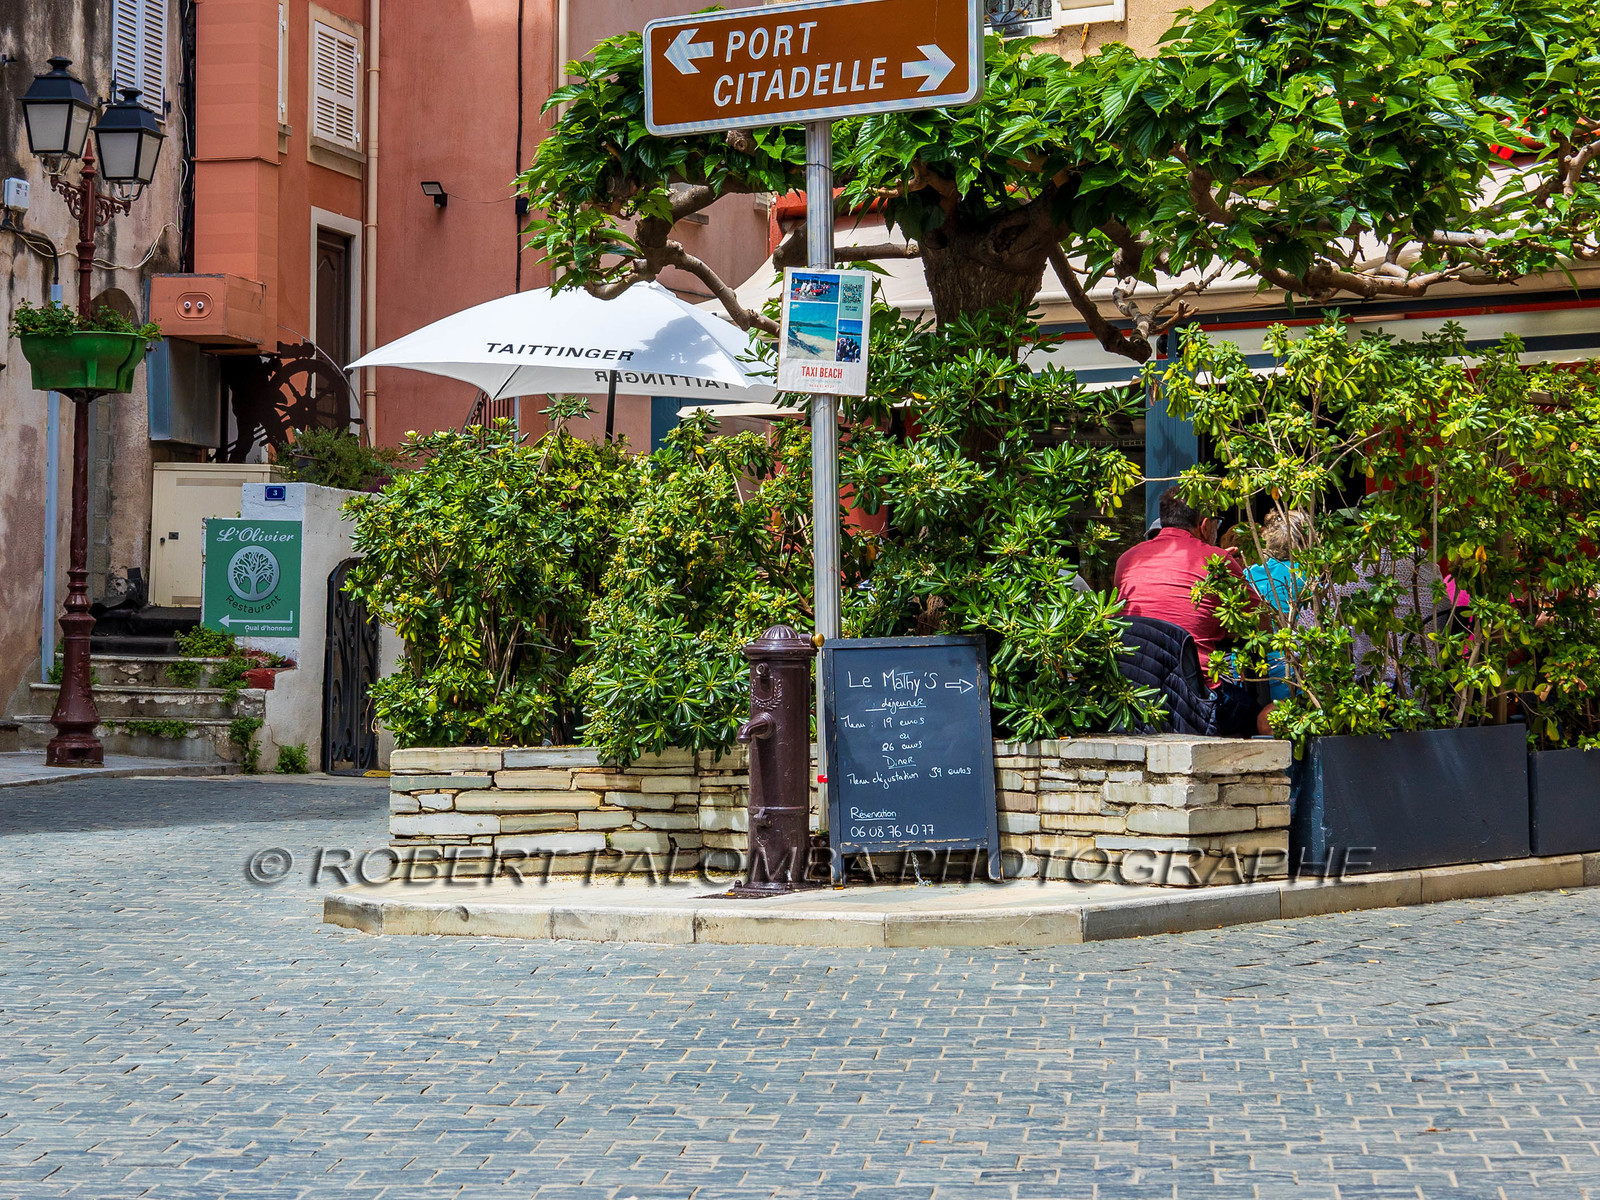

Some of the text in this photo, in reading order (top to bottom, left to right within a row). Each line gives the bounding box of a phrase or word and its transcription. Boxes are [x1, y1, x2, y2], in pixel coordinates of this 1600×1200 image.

[726, 21, 818, 63] PORT
[713, 57, 888, 108] CITADELLE
[486, 342, 635, 362] TAITTINGER
[801, 366, 843, 379] TAXI BEACH
[216, 526, 295, 542] L'Olivier
[225, 594, 282, 614] Restaurant
[847, 670, 873, 688] Le
[840, 715, 866, 729] Menu
[883, 717, 893, 729] 19
[847, 772, 870, 785] Menu
[929, 766, 943, 779] 39
[850, 806, 897, 820] Réservation
[850, 823, 935, 838] 06 08 76 40 77
